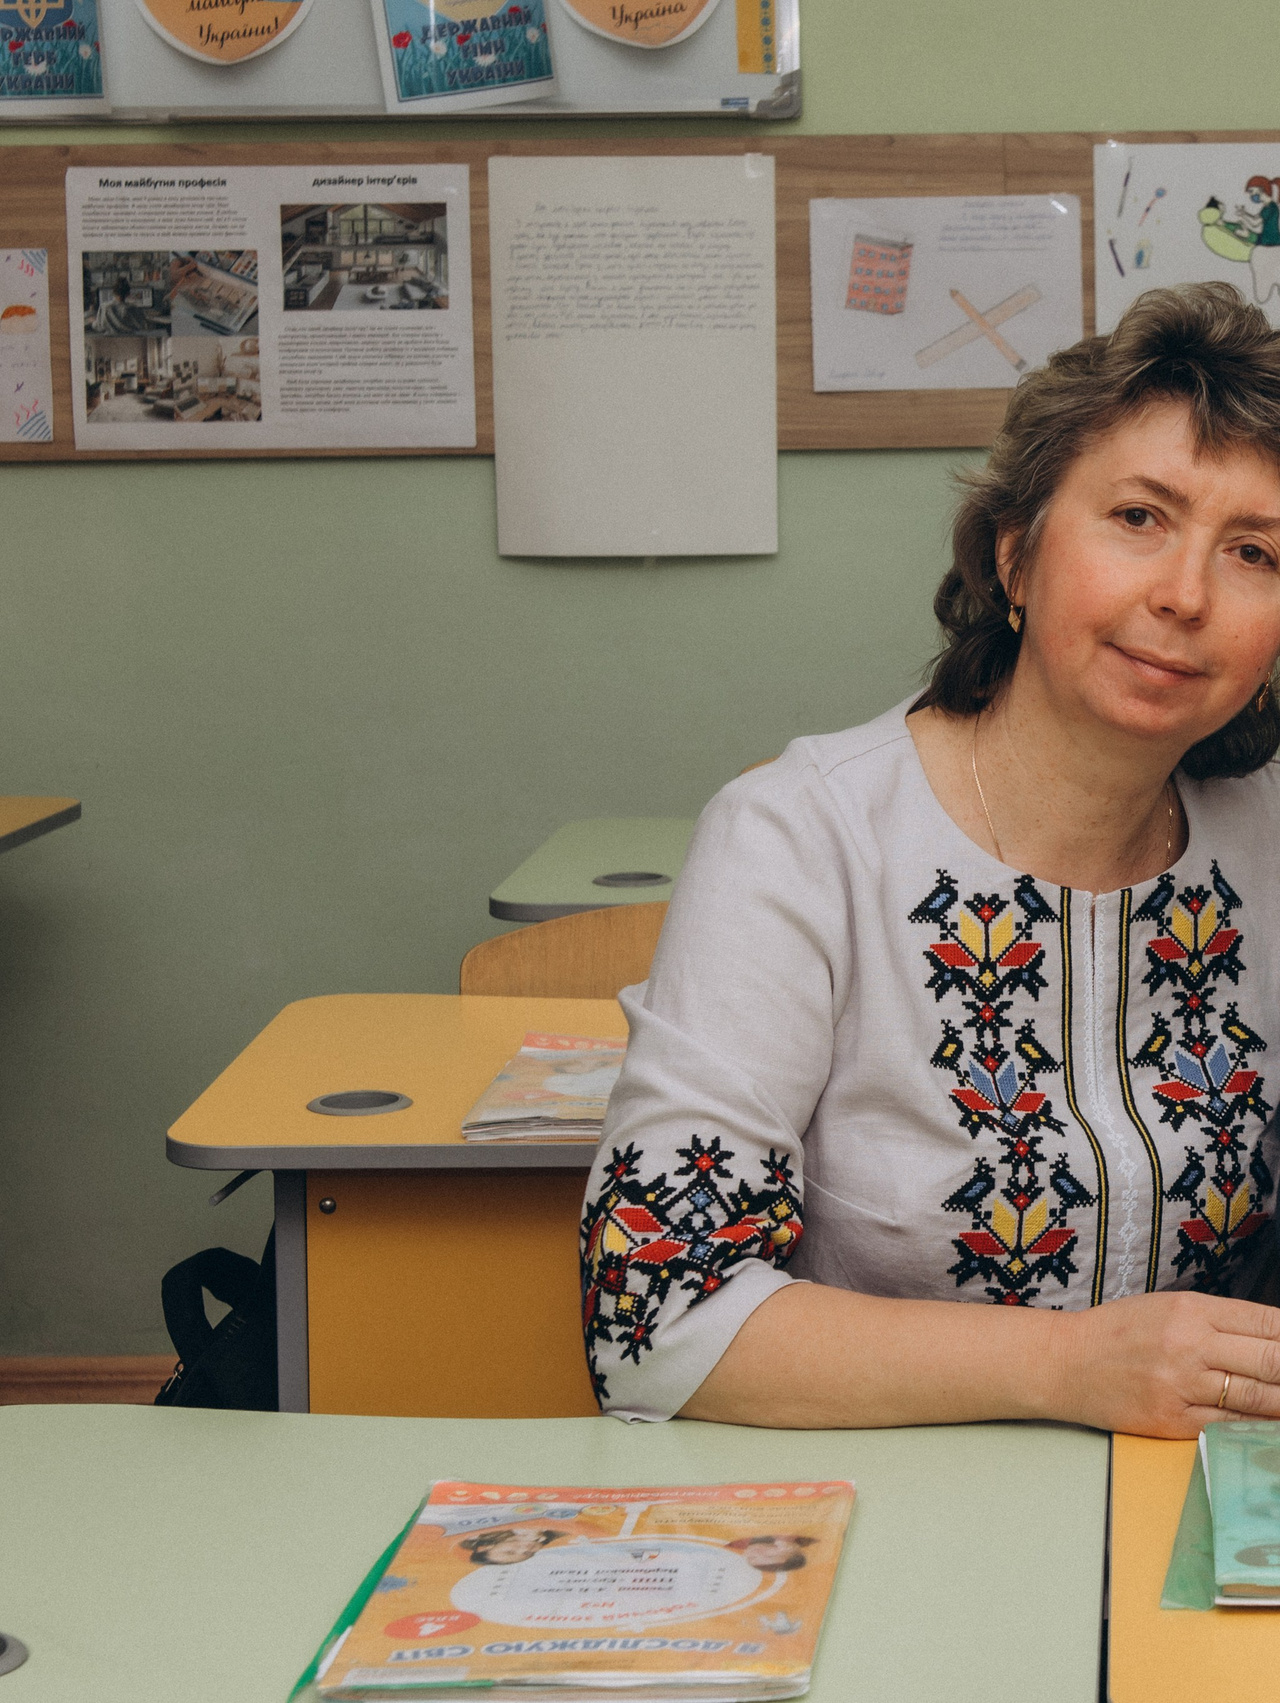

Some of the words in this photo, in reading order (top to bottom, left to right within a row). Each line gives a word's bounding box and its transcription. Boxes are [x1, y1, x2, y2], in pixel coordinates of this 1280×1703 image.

[420, 5, 533, 43] ДЕРЖАВНИЙ
[610, 1, 688, 29] Україна
[197, 15, 280, 50] України!
[98, 178, 122, 188] Моя
[124, 177, 176, 189] майбутня
[178, 176, 227, 190] професія
[312, 175, 365, 187] дизайнер
[417, 1622, 447, 1637] 4
[388, 1644, 473, 1662] СВІТ
[483, 1637, 731, 1655] ДОСЛІДЖУЮ
